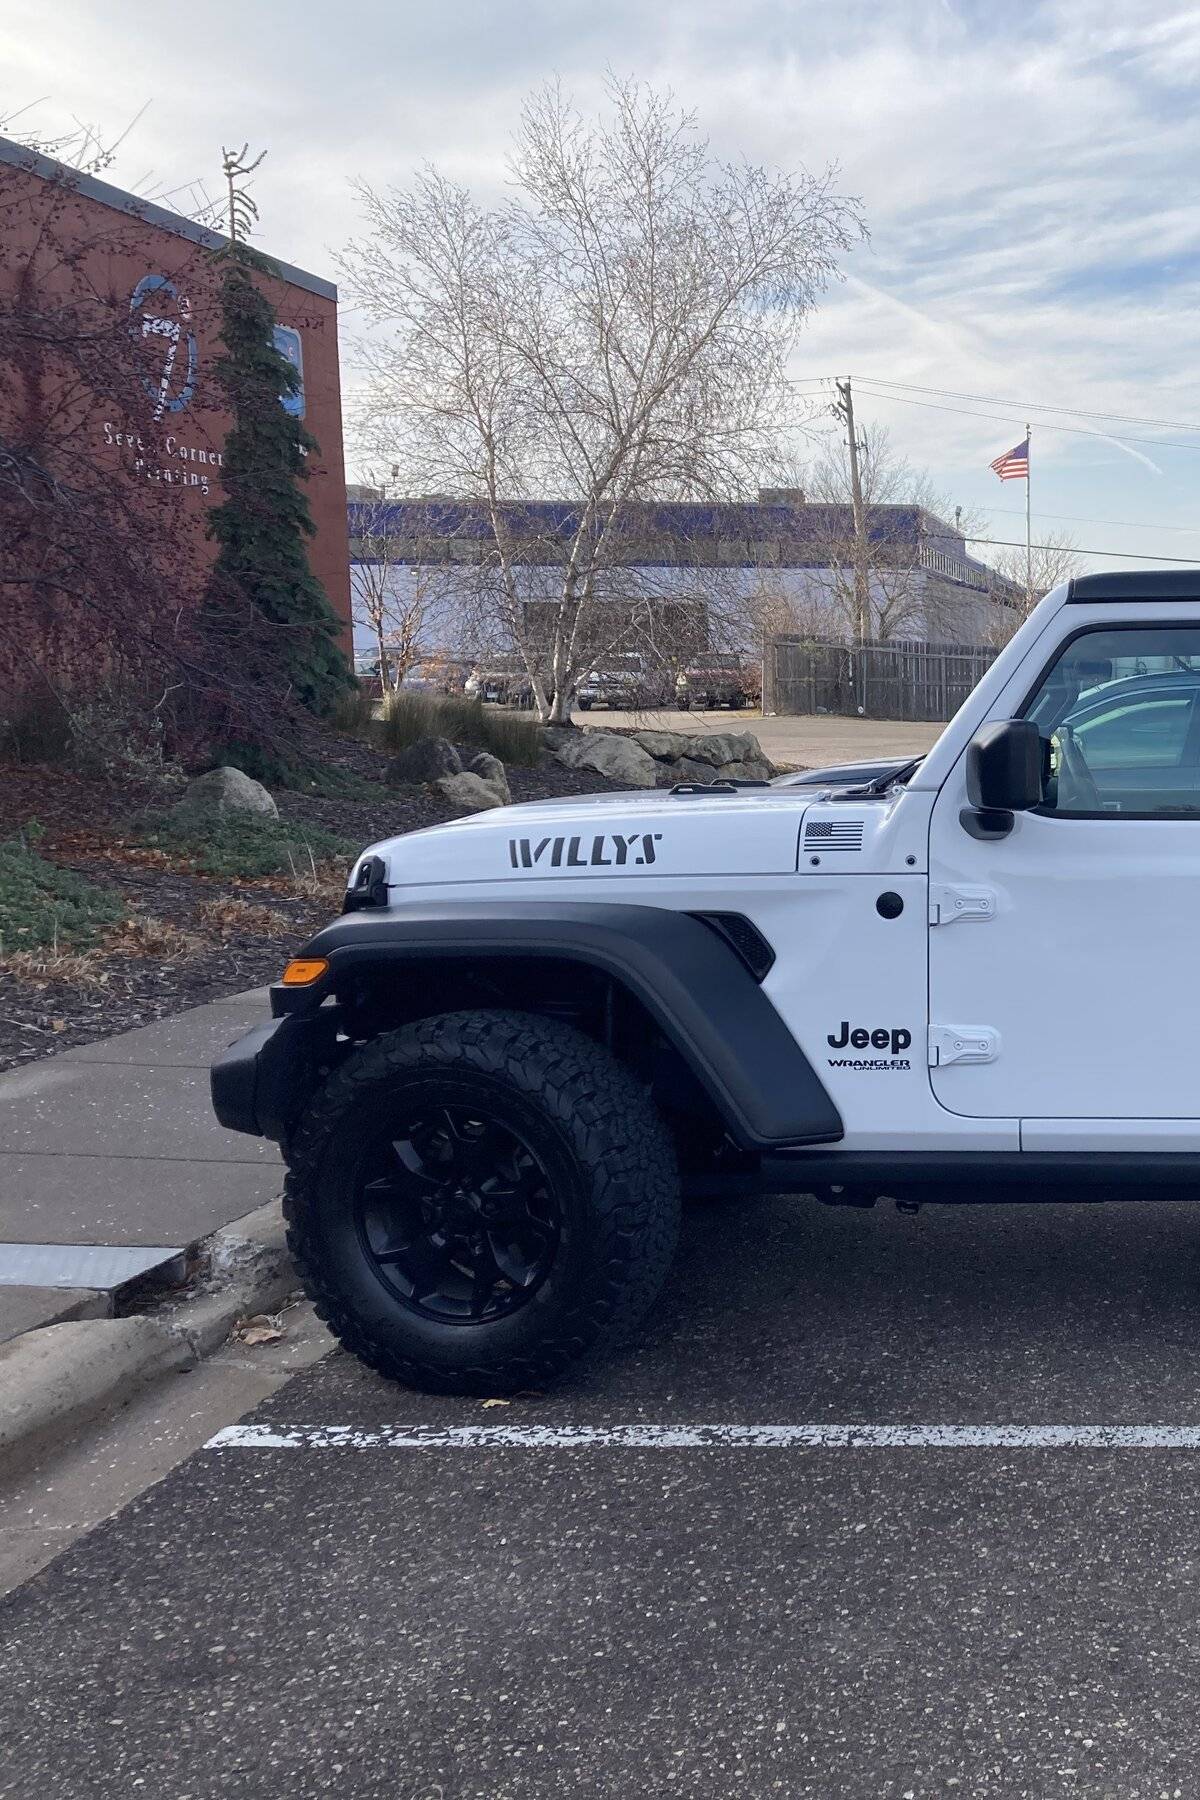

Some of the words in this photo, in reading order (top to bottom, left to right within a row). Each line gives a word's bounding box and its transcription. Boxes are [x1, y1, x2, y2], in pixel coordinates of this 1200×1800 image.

[104, 422, 156, 453] Seve
[166, 436, 223, 466] Corner
[509, 833, 663, 869] WILLYS
[827, 1021, 911, 1055] Jeep
[827, 1059, 911, 1067] WRANGLER
